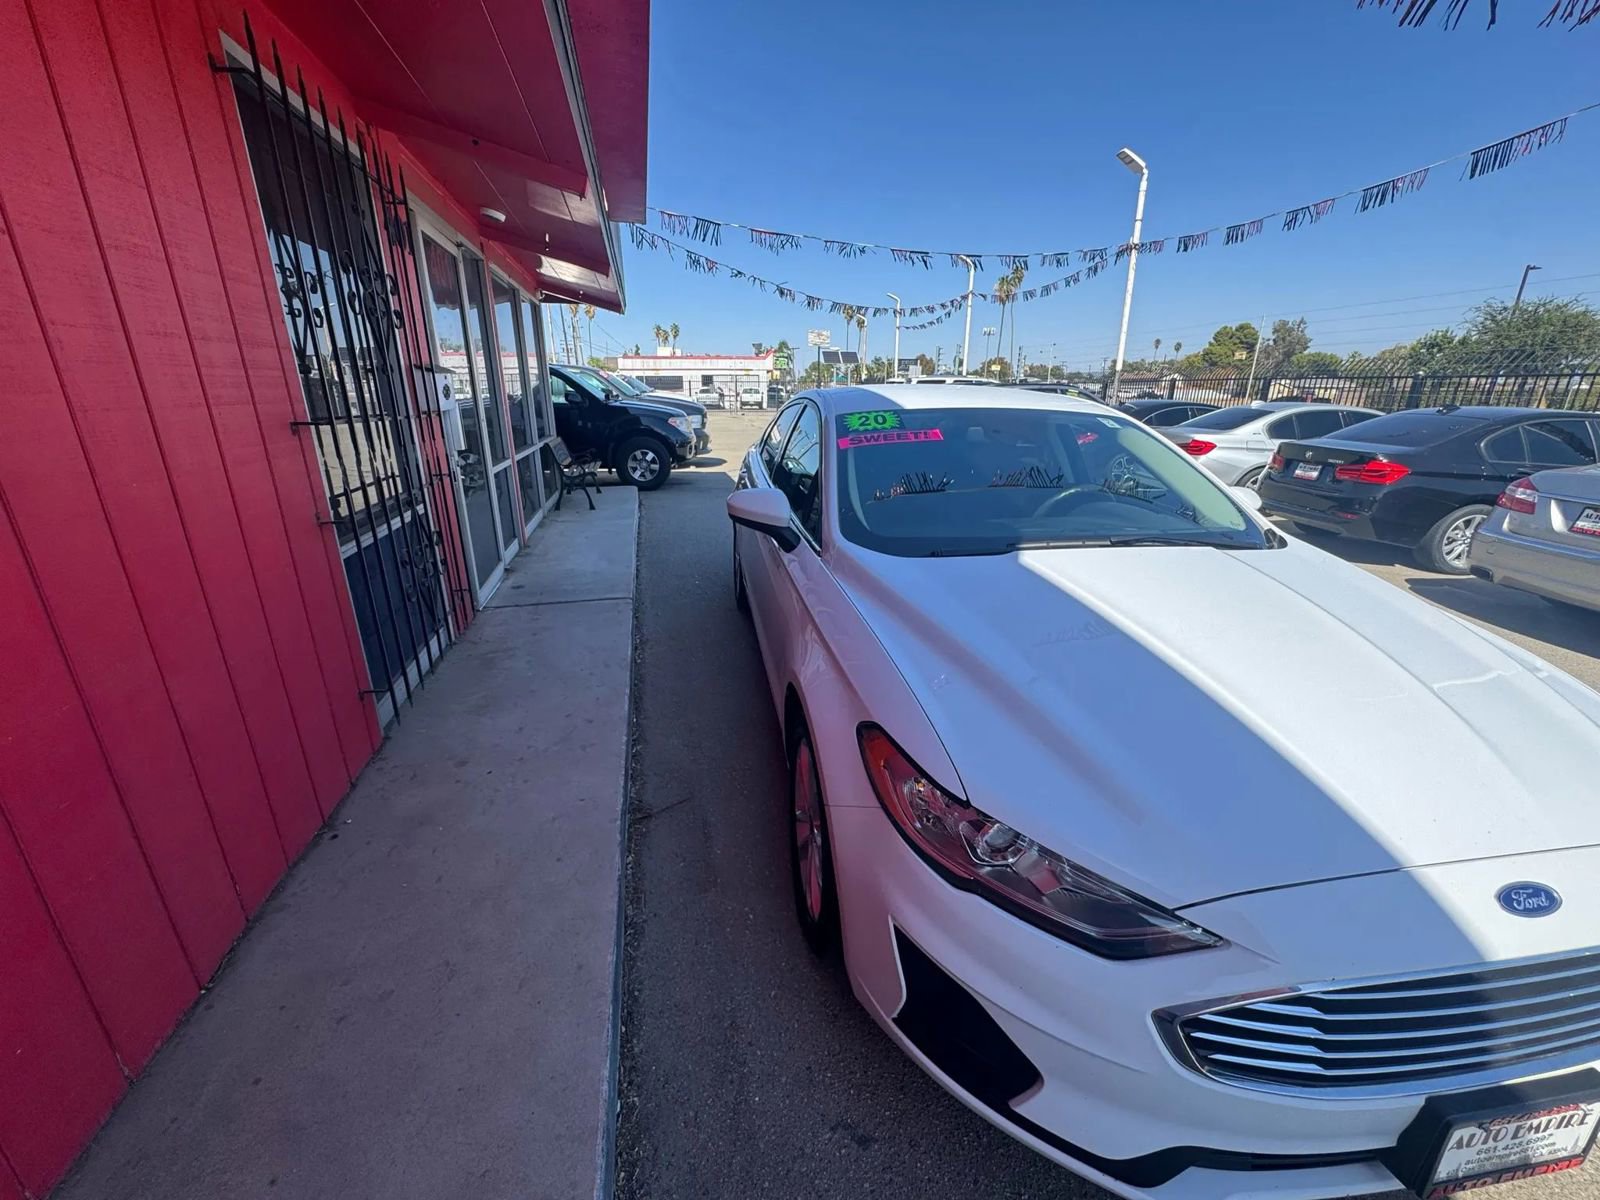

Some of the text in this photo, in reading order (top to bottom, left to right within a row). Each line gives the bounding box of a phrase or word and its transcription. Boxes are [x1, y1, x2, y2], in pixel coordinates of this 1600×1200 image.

[857, 413, 888, 427] 20
[848, 431, 930, 446] SWEET!
[1511, 888, 1550, 910] Ford
[1448, 1125, 1509, 1152] AUTO
[1511, 1111, 1593, 1141] EMPIRE
[1427, 1177, 1491, 1200] AUTO
[1496, 1157, 1585, 1183] EMPIRE
